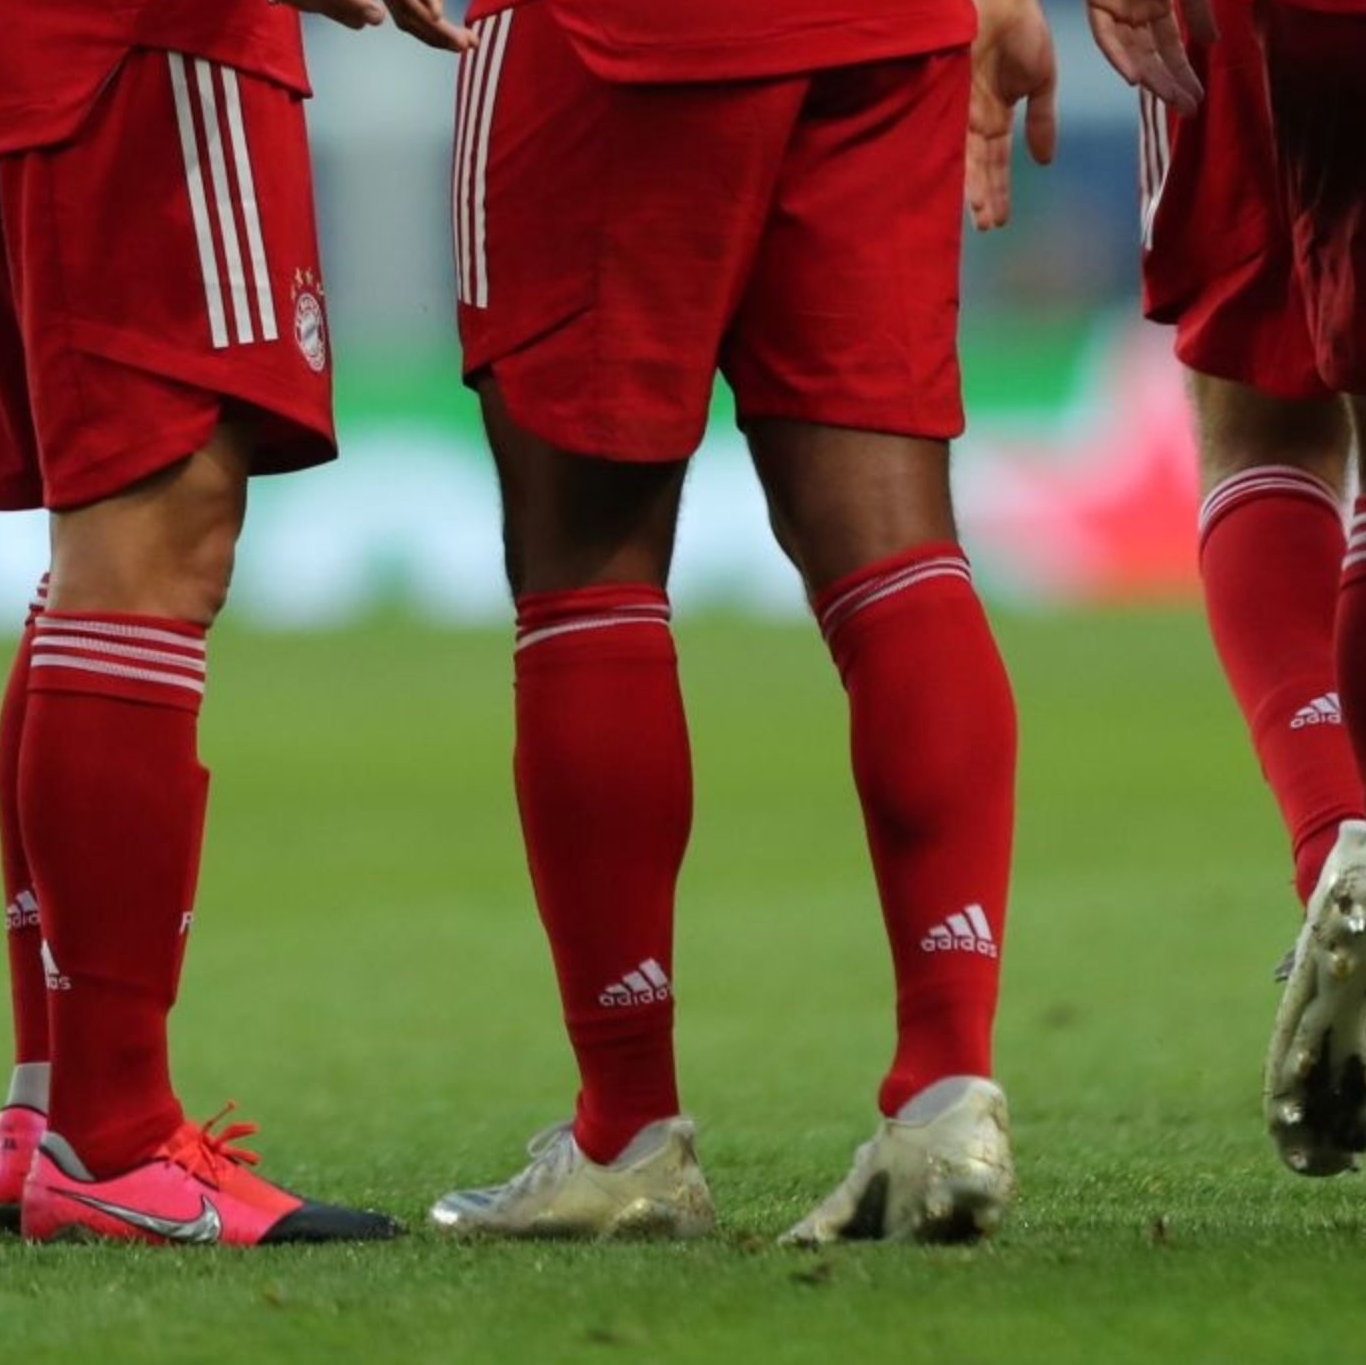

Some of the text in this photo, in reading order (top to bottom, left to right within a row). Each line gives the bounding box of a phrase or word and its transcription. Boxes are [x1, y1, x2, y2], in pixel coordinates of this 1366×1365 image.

[1290, 711, 1341, 729] adid
[920, 935, 998, 959] adidas
[599, 985, 669, 1007] adida
